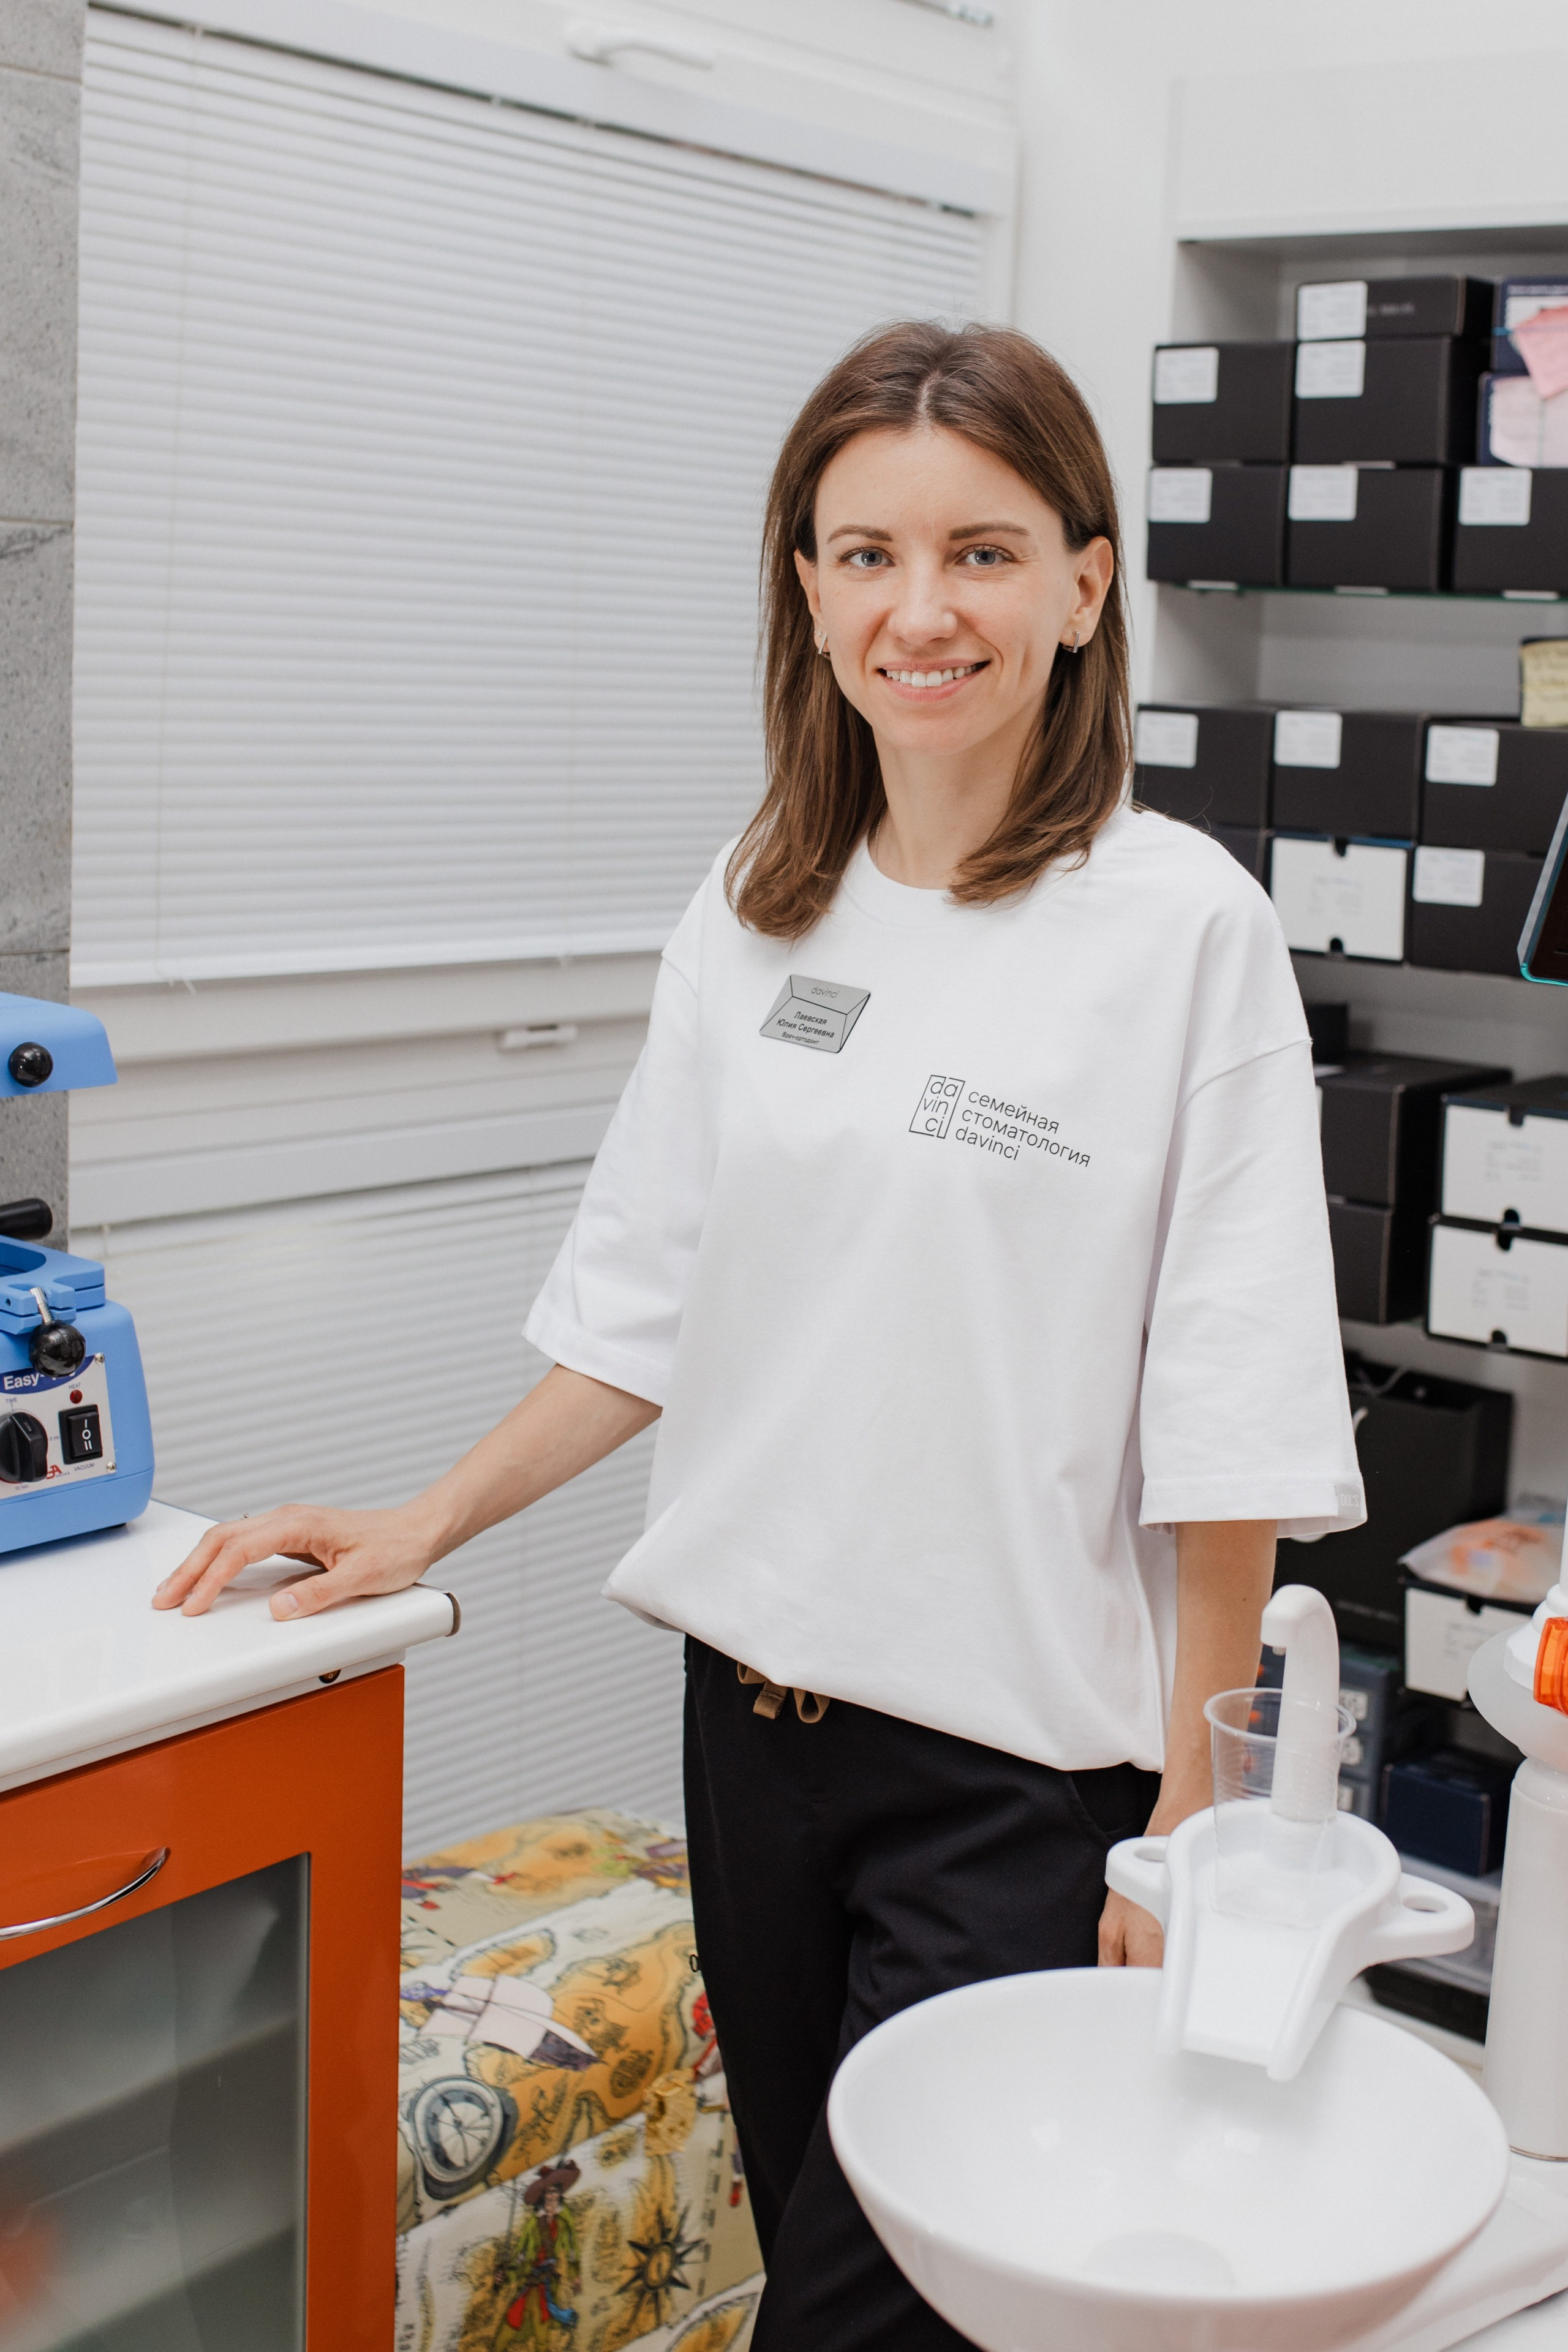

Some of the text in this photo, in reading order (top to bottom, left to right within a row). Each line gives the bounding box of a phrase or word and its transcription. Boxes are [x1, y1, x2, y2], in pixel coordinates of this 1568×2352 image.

[811, 987, 839, 998] davinci
[794, 1011, 827, 1025] Лаевская
[776, 1018, 835, 1038] Юлия Сергеевна
[782, 1031, 820, 1045] Врач-ортодонт
[968, 1091, 1060, 1134] семейная
[956, 1126, 1020, 1161] davinci
[962, 1110, 1091, 1167] стоматология
[74, 1462, 95, 1471] VACUUM
